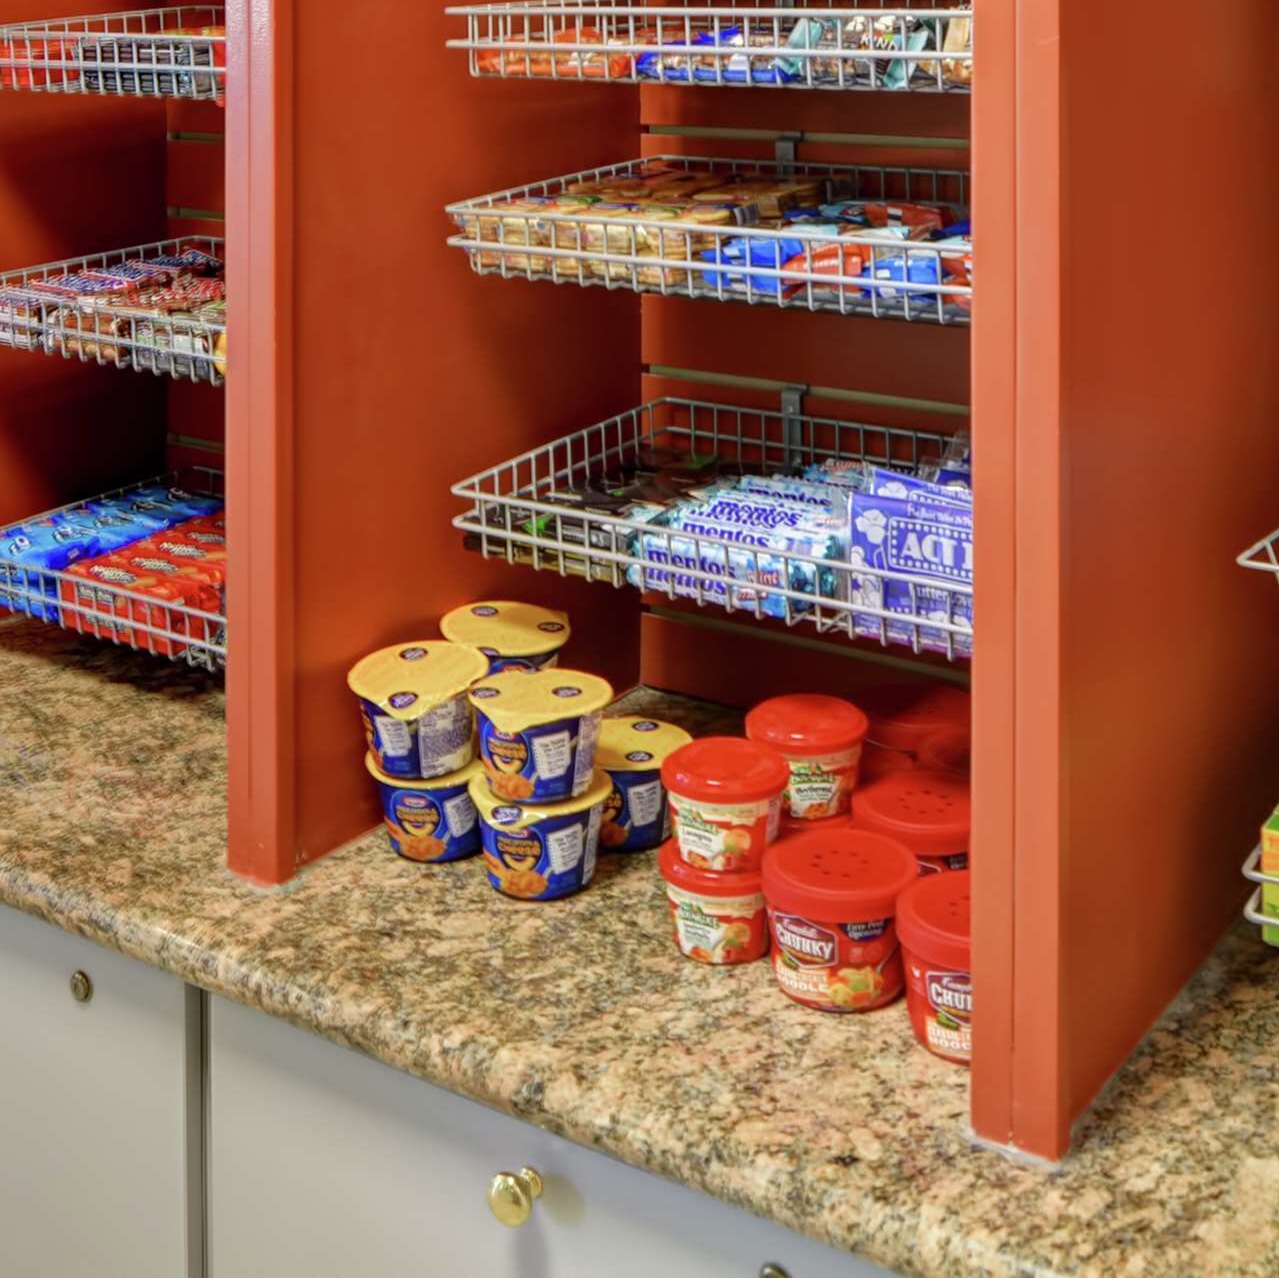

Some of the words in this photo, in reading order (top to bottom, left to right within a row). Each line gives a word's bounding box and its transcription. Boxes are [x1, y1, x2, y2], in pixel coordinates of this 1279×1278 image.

[859, 33, 898, 51] KND
[746, 487, 833, 508] mentos
[900, 530, 959, 568] ACT
[646, 548, 737, 579] mentos
[916, 586, 949, 601] utter
[775, 922, 834, 961] CHUNKY
